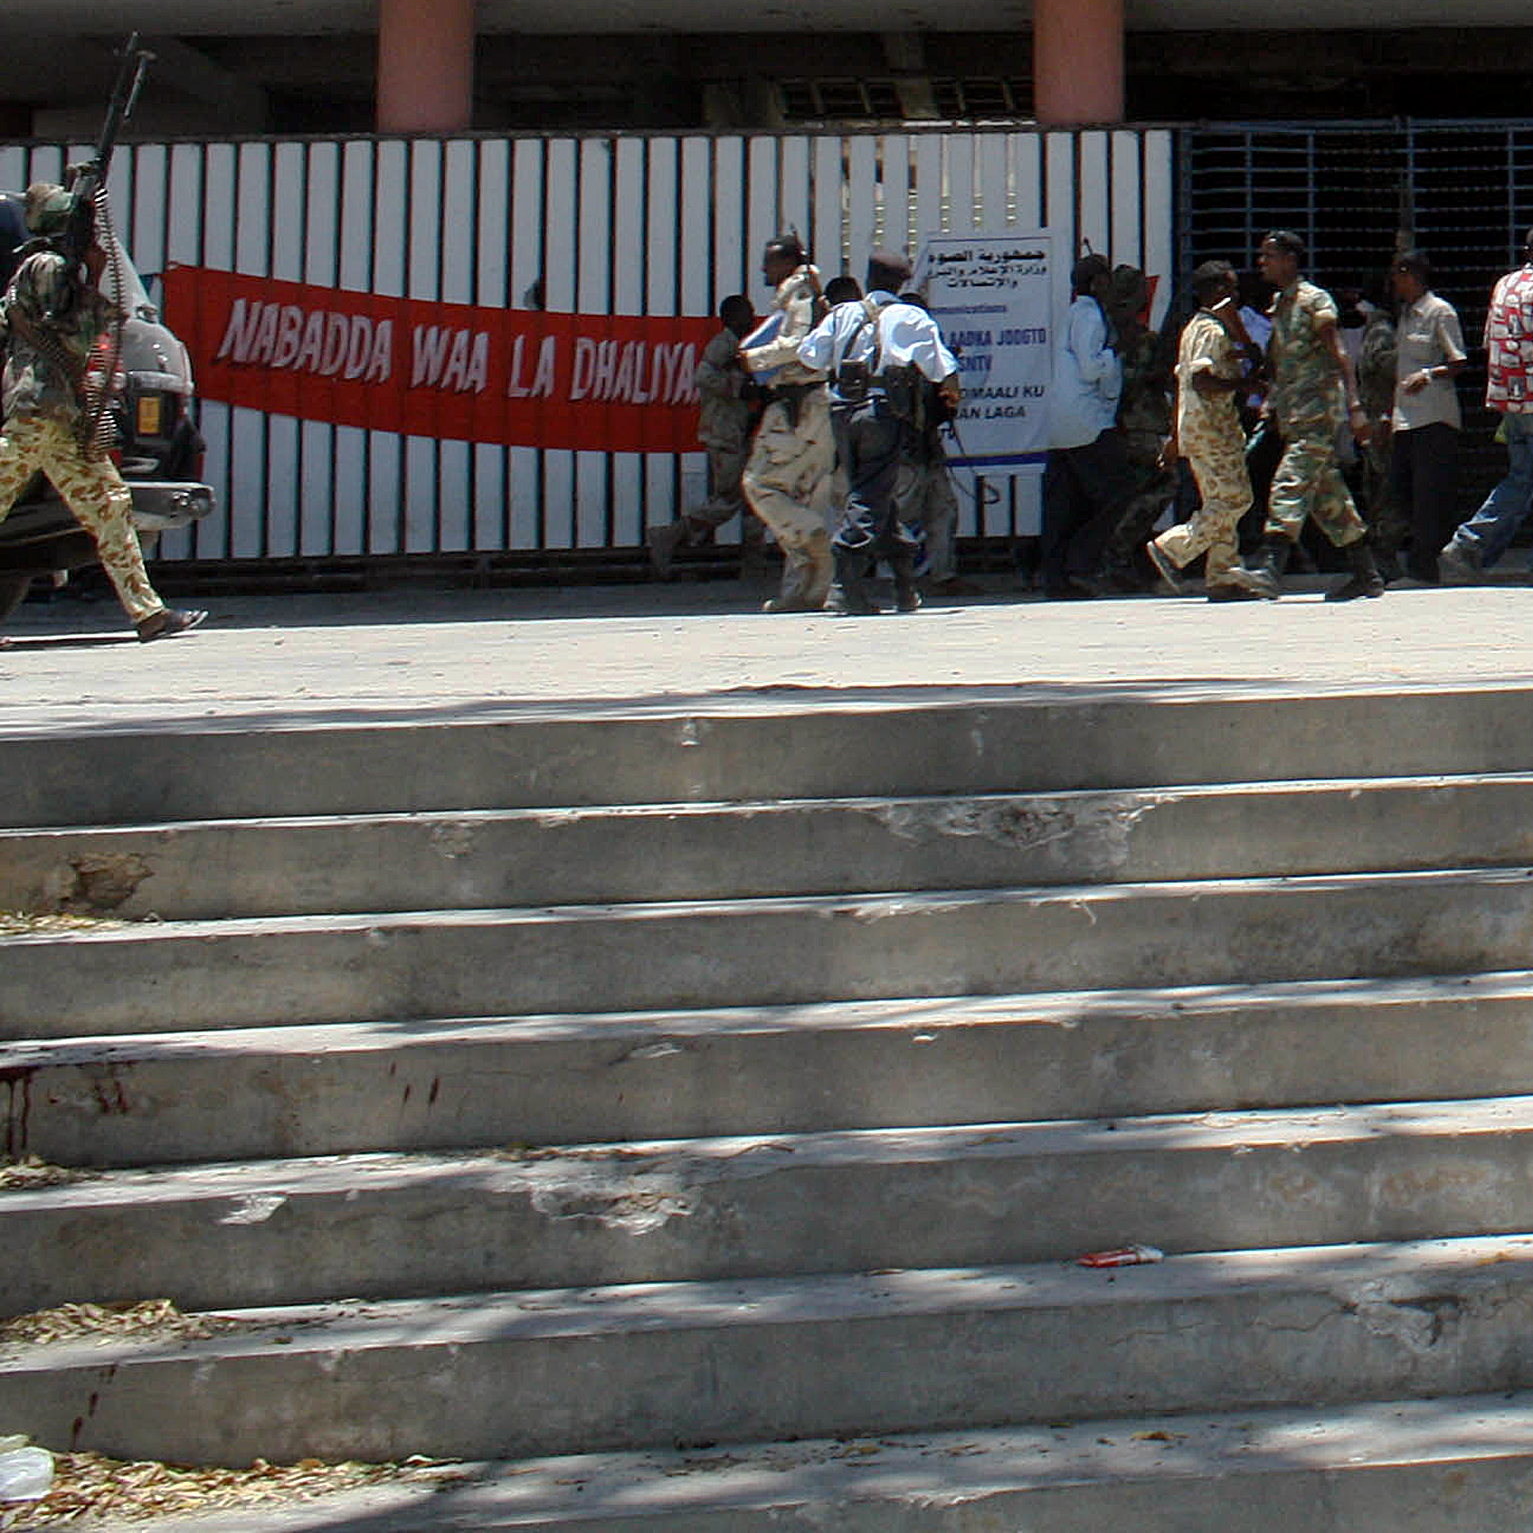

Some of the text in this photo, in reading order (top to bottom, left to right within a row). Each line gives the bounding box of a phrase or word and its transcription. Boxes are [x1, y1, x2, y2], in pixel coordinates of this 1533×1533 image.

[216, 297, 701, 406] NABADDA WAA LA DHALIYA
